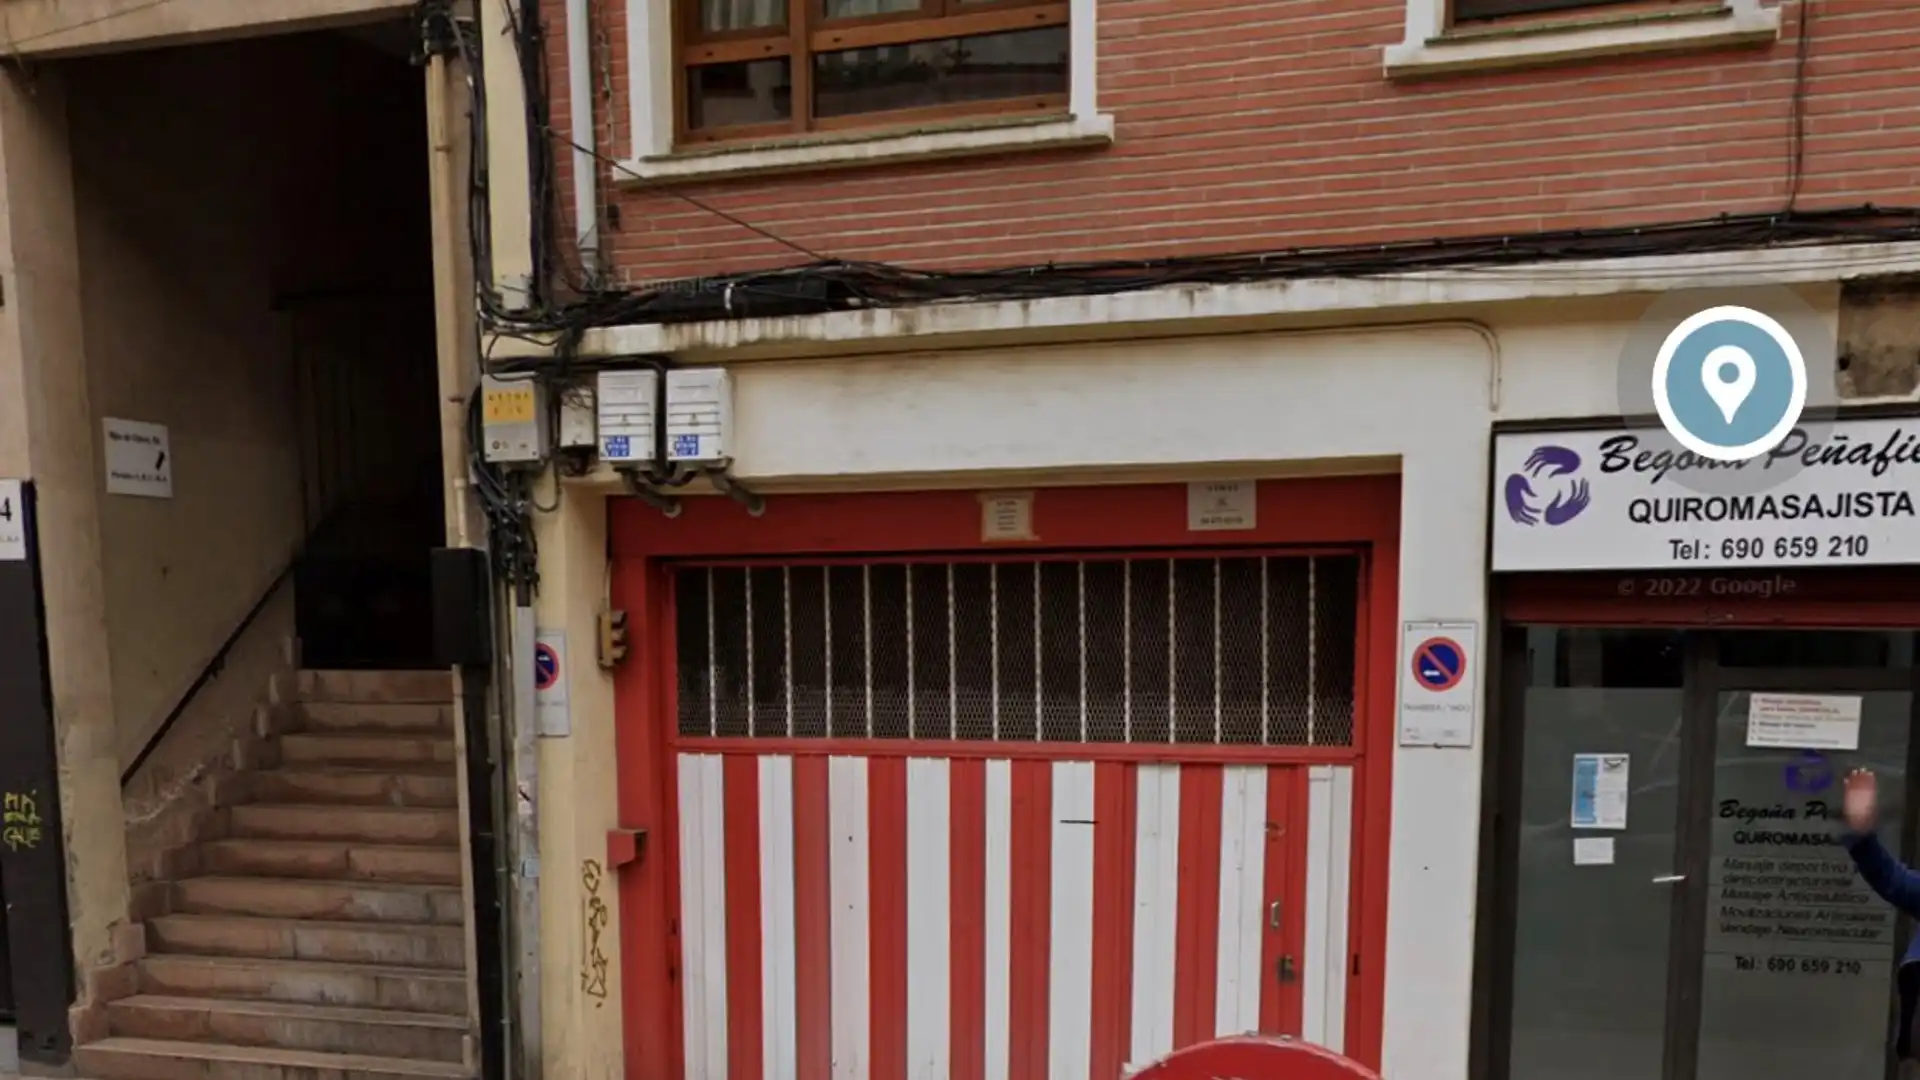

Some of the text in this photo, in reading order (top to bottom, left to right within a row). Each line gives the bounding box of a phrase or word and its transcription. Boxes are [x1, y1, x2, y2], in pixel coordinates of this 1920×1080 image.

[1628, 491, 1915, 524] QUIROMASAJISTA
[1669, 535, 1869, 560] Tel: 690 659 210
[1719, 799, 1796, 825] Begoña
[1767, 956, 1796, 973] 690
[1801, 958, 1830, 973] 659
[1835, 960, 1862, 976] 210
